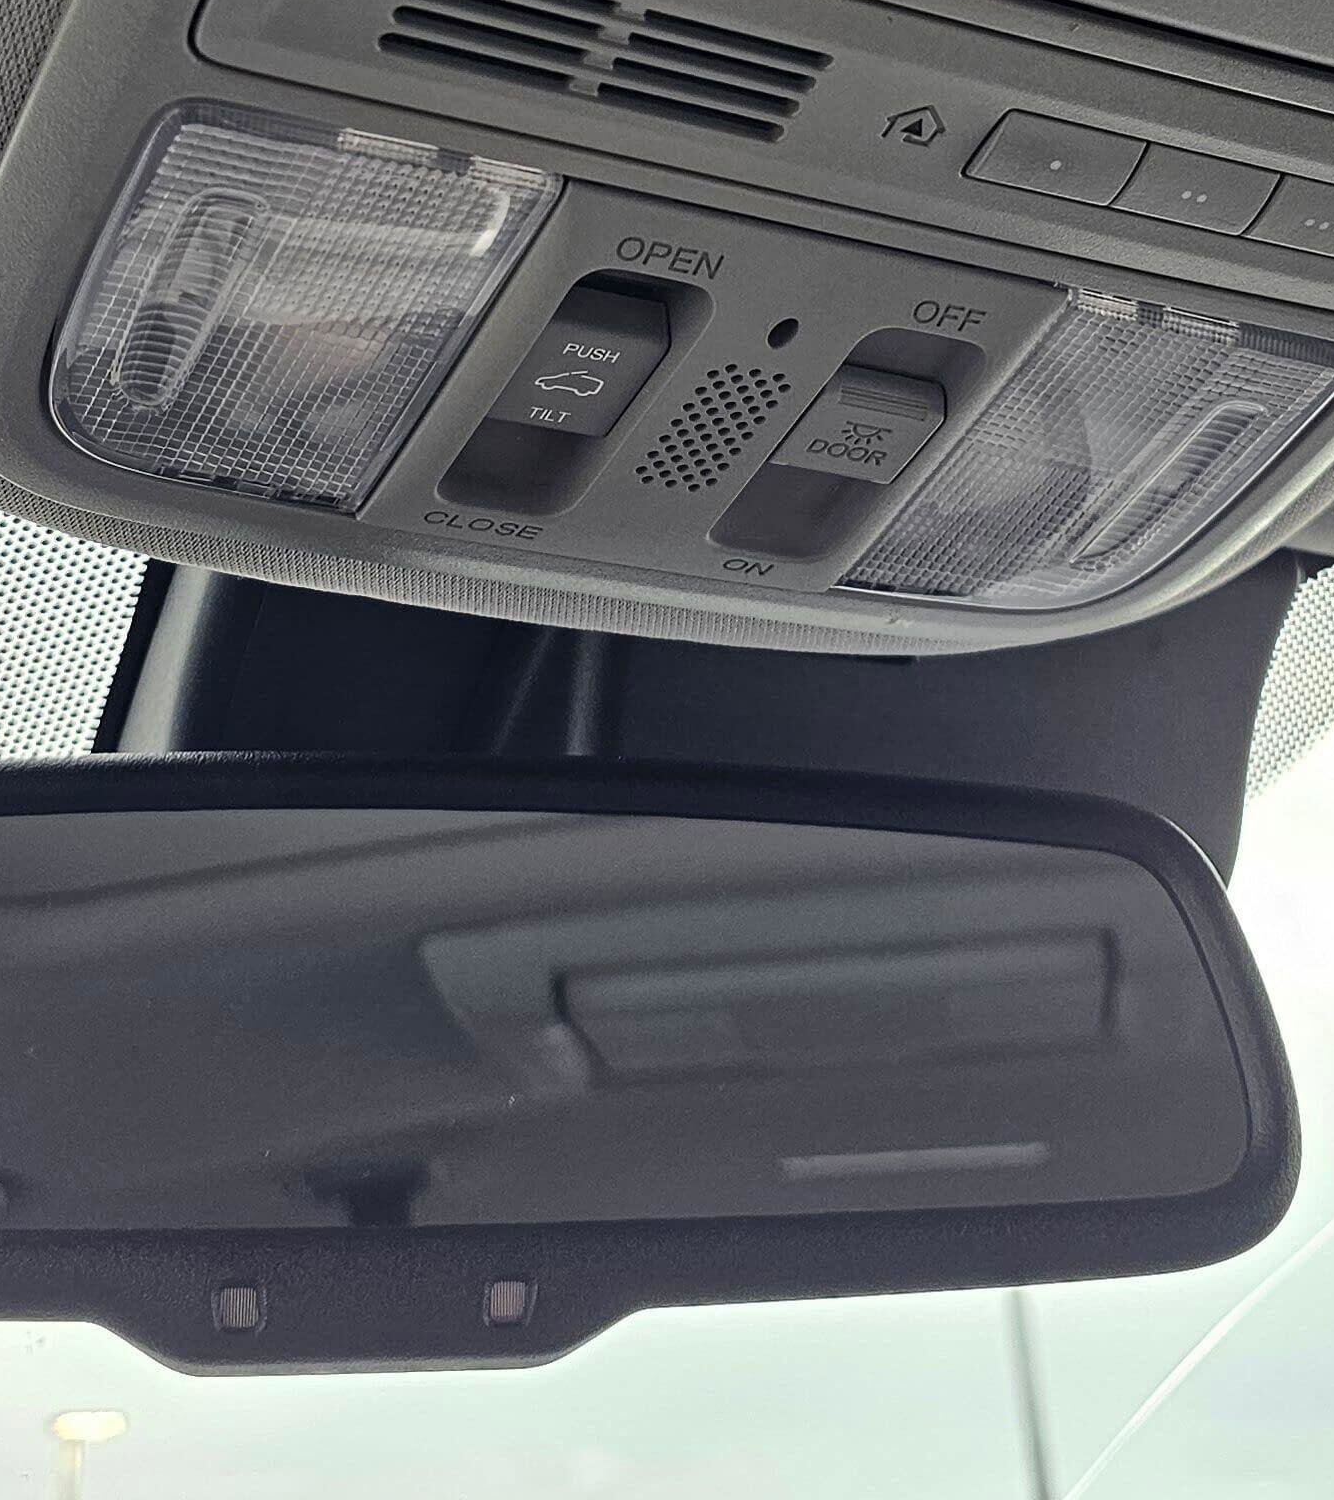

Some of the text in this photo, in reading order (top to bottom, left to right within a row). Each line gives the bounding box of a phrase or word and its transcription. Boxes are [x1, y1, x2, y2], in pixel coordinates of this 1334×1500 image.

[615, 235, 725, 282] OPEN
[912, 299, 988, 334] OFF
[562, 342, 621, 365] PUSH
[528, 406, 572, 425] TILT
[806, 437, 888, 468] DOOR
[422, 509, 544, 541] CLOSE
[721, 557, 775, 578] ON
